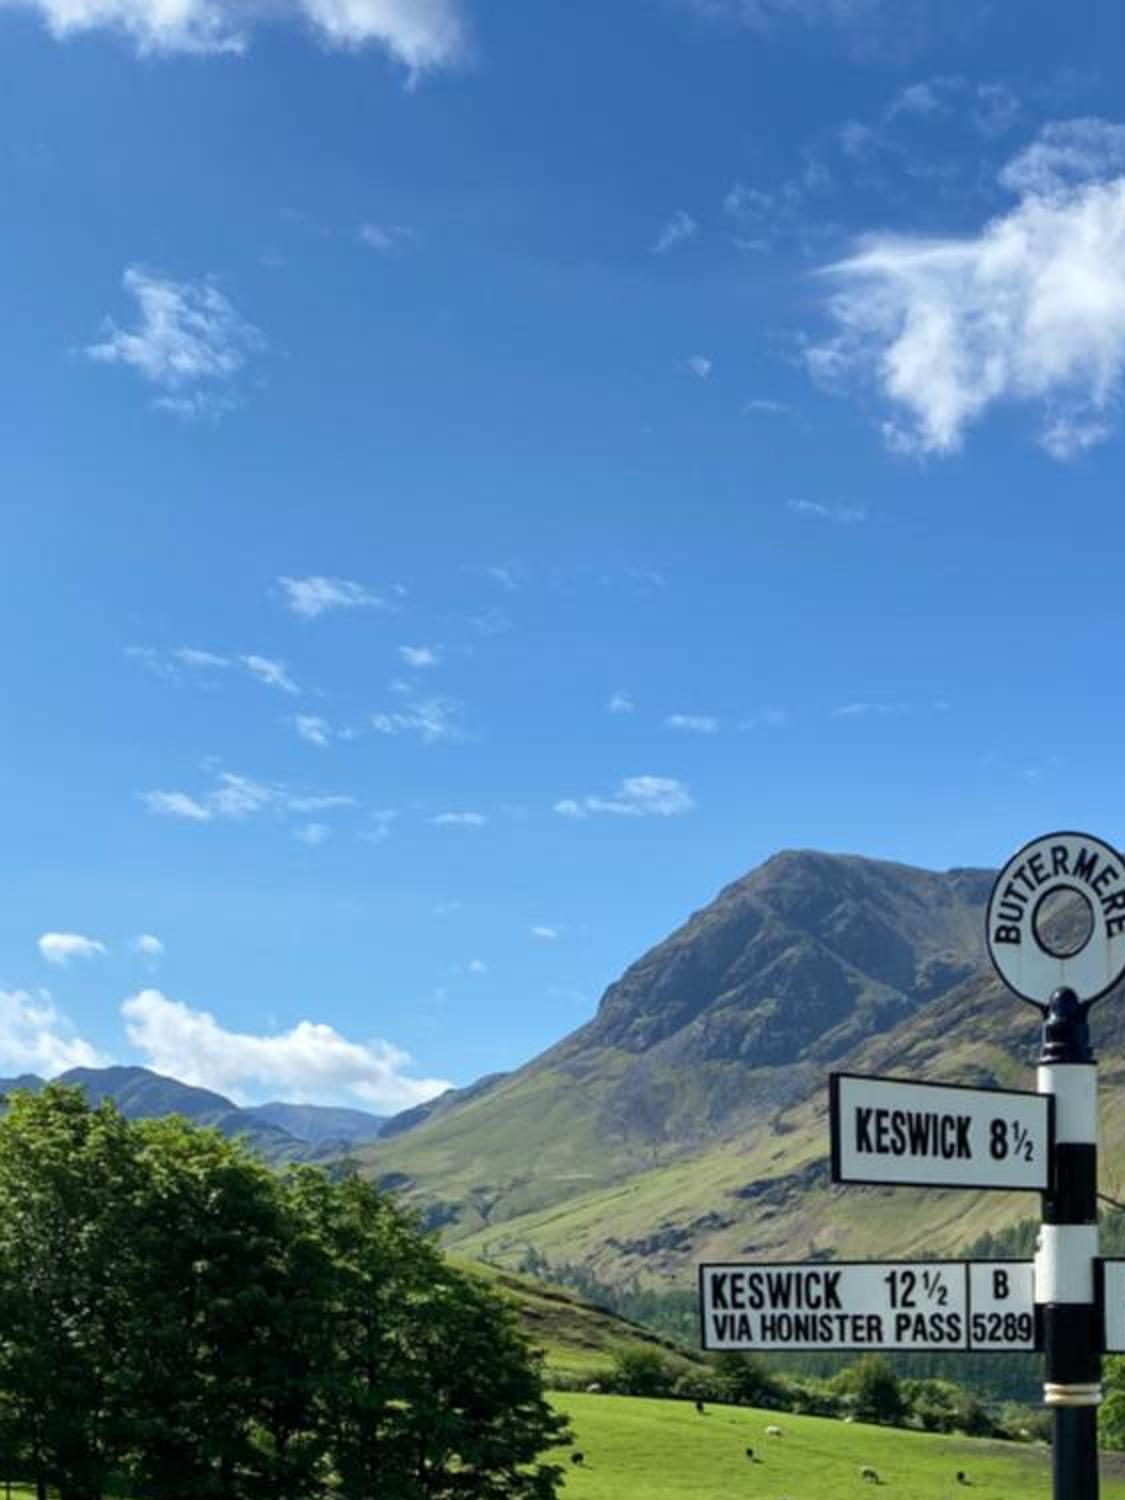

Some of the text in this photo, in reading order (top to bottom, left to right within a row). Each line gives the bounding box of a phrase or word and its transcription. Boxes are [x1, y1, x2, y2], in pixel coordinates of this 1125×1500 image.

[855, 1106, 973, 1160] KESWICK
[710, 1270, 843, 1311] KESWICK
[992, 1269, 1010, 1301] B
[712, 1313, 962, 1344] VIA HONISTER PASS
[971, 1312, 1034, 1344] 5289
